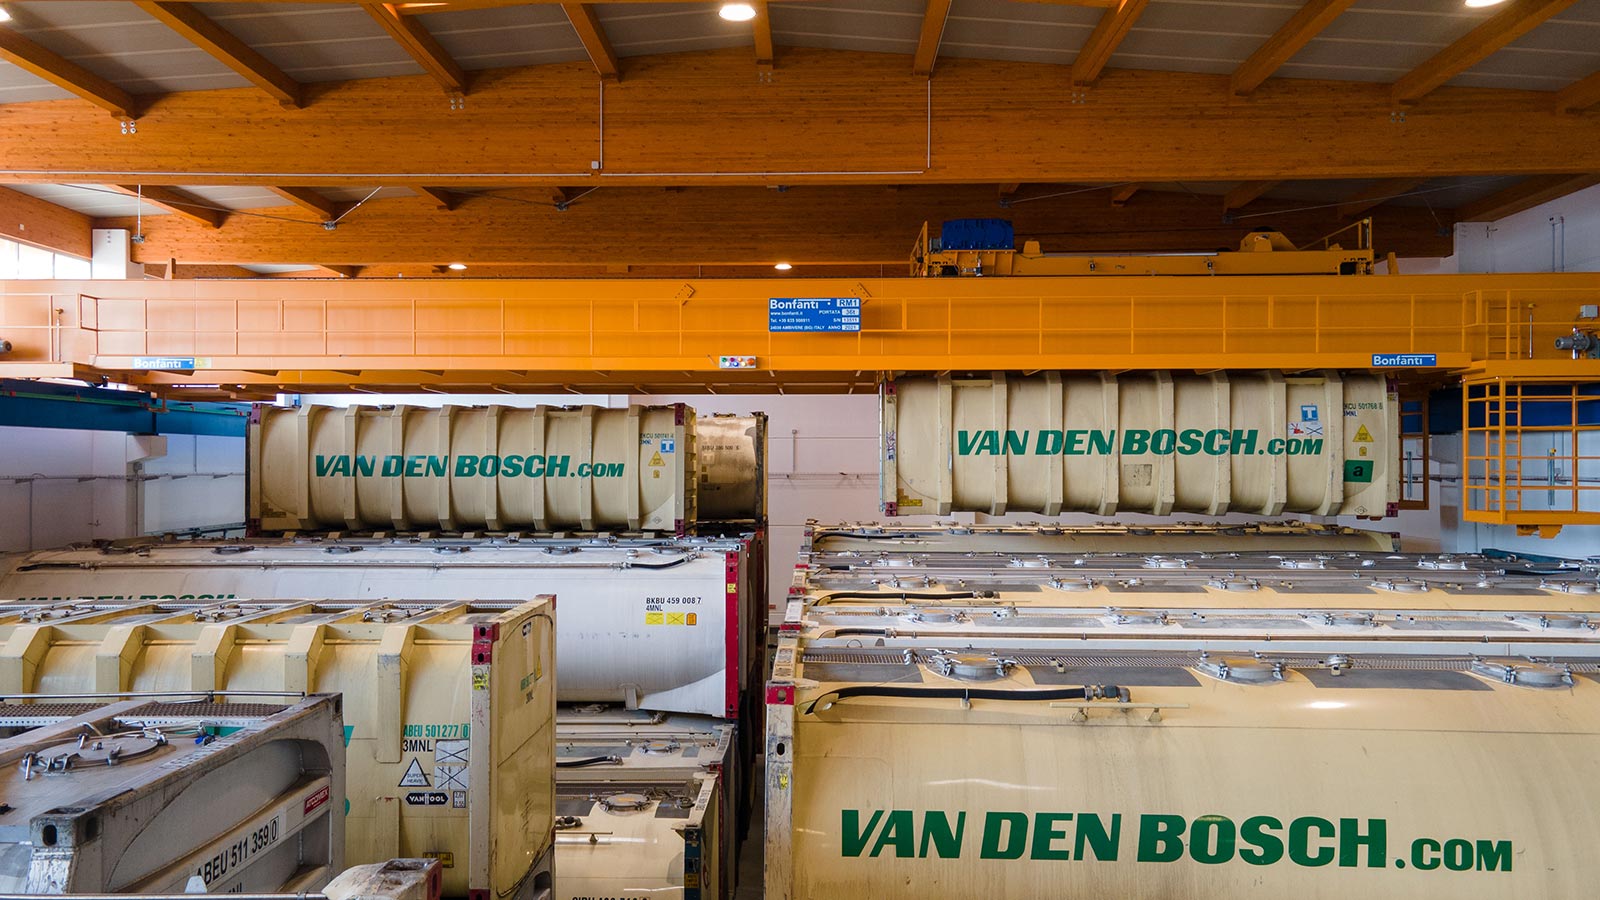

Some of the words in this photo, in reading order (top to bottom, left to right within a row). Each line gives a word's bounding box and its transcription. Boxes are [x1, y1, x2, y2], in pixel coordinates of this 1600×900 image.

[770, 299, 819, 309] Bonfanti
[134, 358, 181, 369] Bonfanti
[1373, 355, 1423, 365] Bonfanti
[957, 429, 1029, 456] VAN
[1035, 429, 1116, 456] DEN
[315, 455, 376, 478] VAN
[381, 455, 449, 478] DEN
[403, 724, 423, 737] ABEU
[425, 724, 459, 737] 501277
[462, 725, 469, 737] 0
[402, 739, 434, 752] 3MNL
[841, 808, 967, 859] VAN
[979, 811, 1122, 862] DEN
[231, 837, 248, 867] 511
[251, 825, 269, 854] 359
